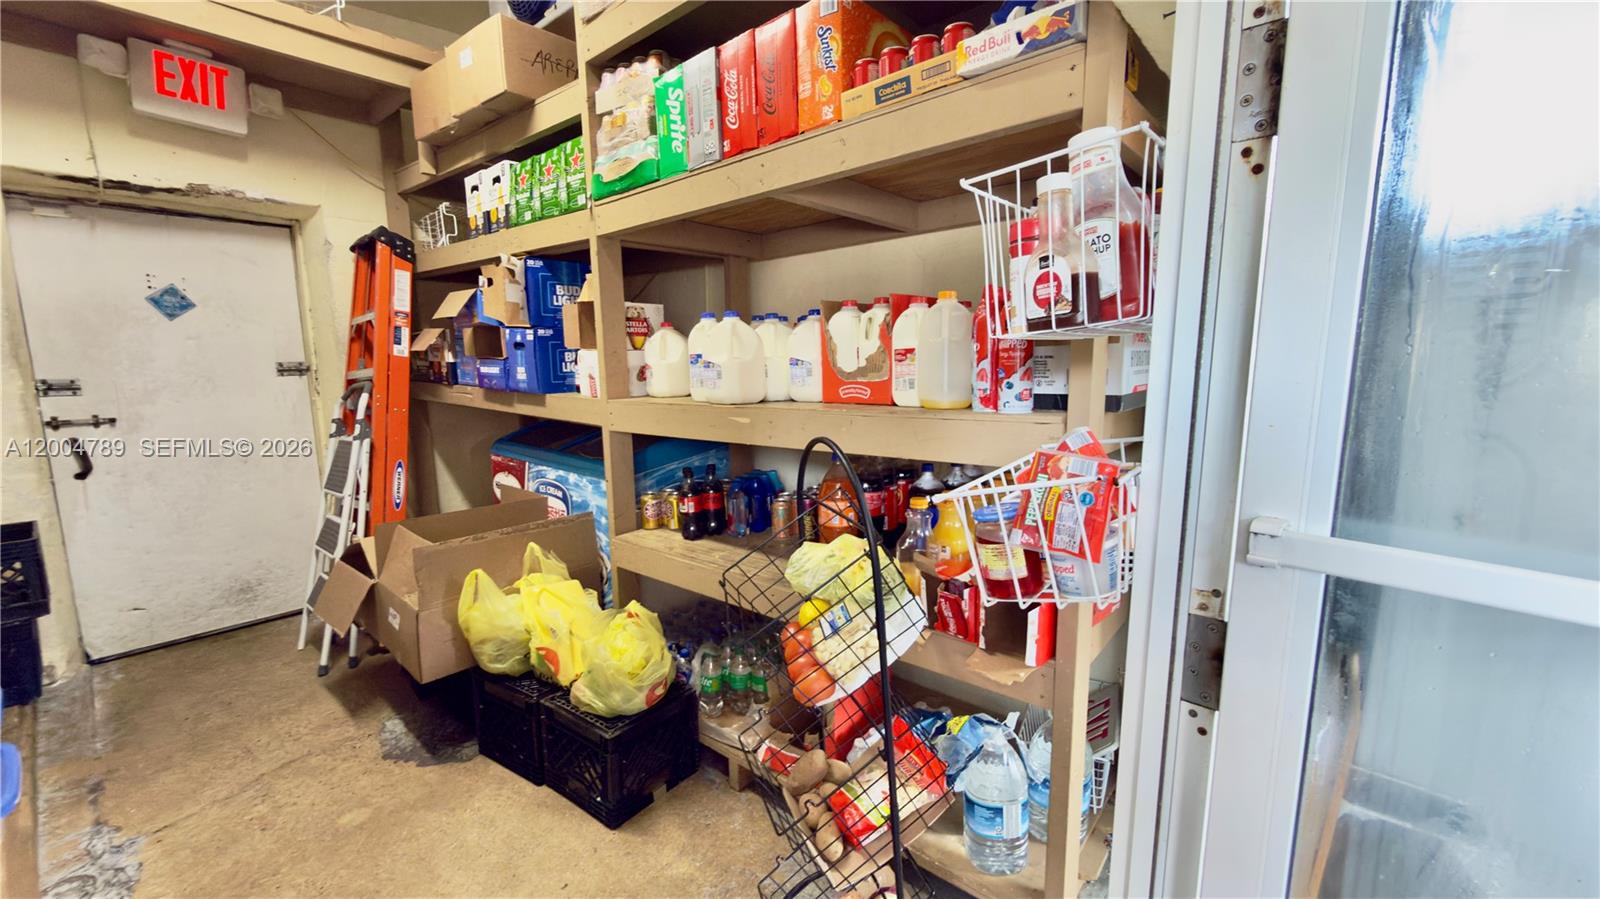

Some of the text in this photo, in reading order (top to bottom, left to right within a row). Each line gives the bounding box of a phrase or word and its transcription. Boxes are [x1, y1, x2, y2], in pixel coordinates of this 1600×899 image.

[816, 25, 837, 72] Sunkist
[965, 29, 1011, 57] Red Bull
[152, 49, 230, 111] EXIT
[725, 68, 739, 129] Coca-Cola
[666, 87, 686, 153] Sprite
[553, 295, 577, 306] LIGH
[555, 284, 581, 296] BUD
